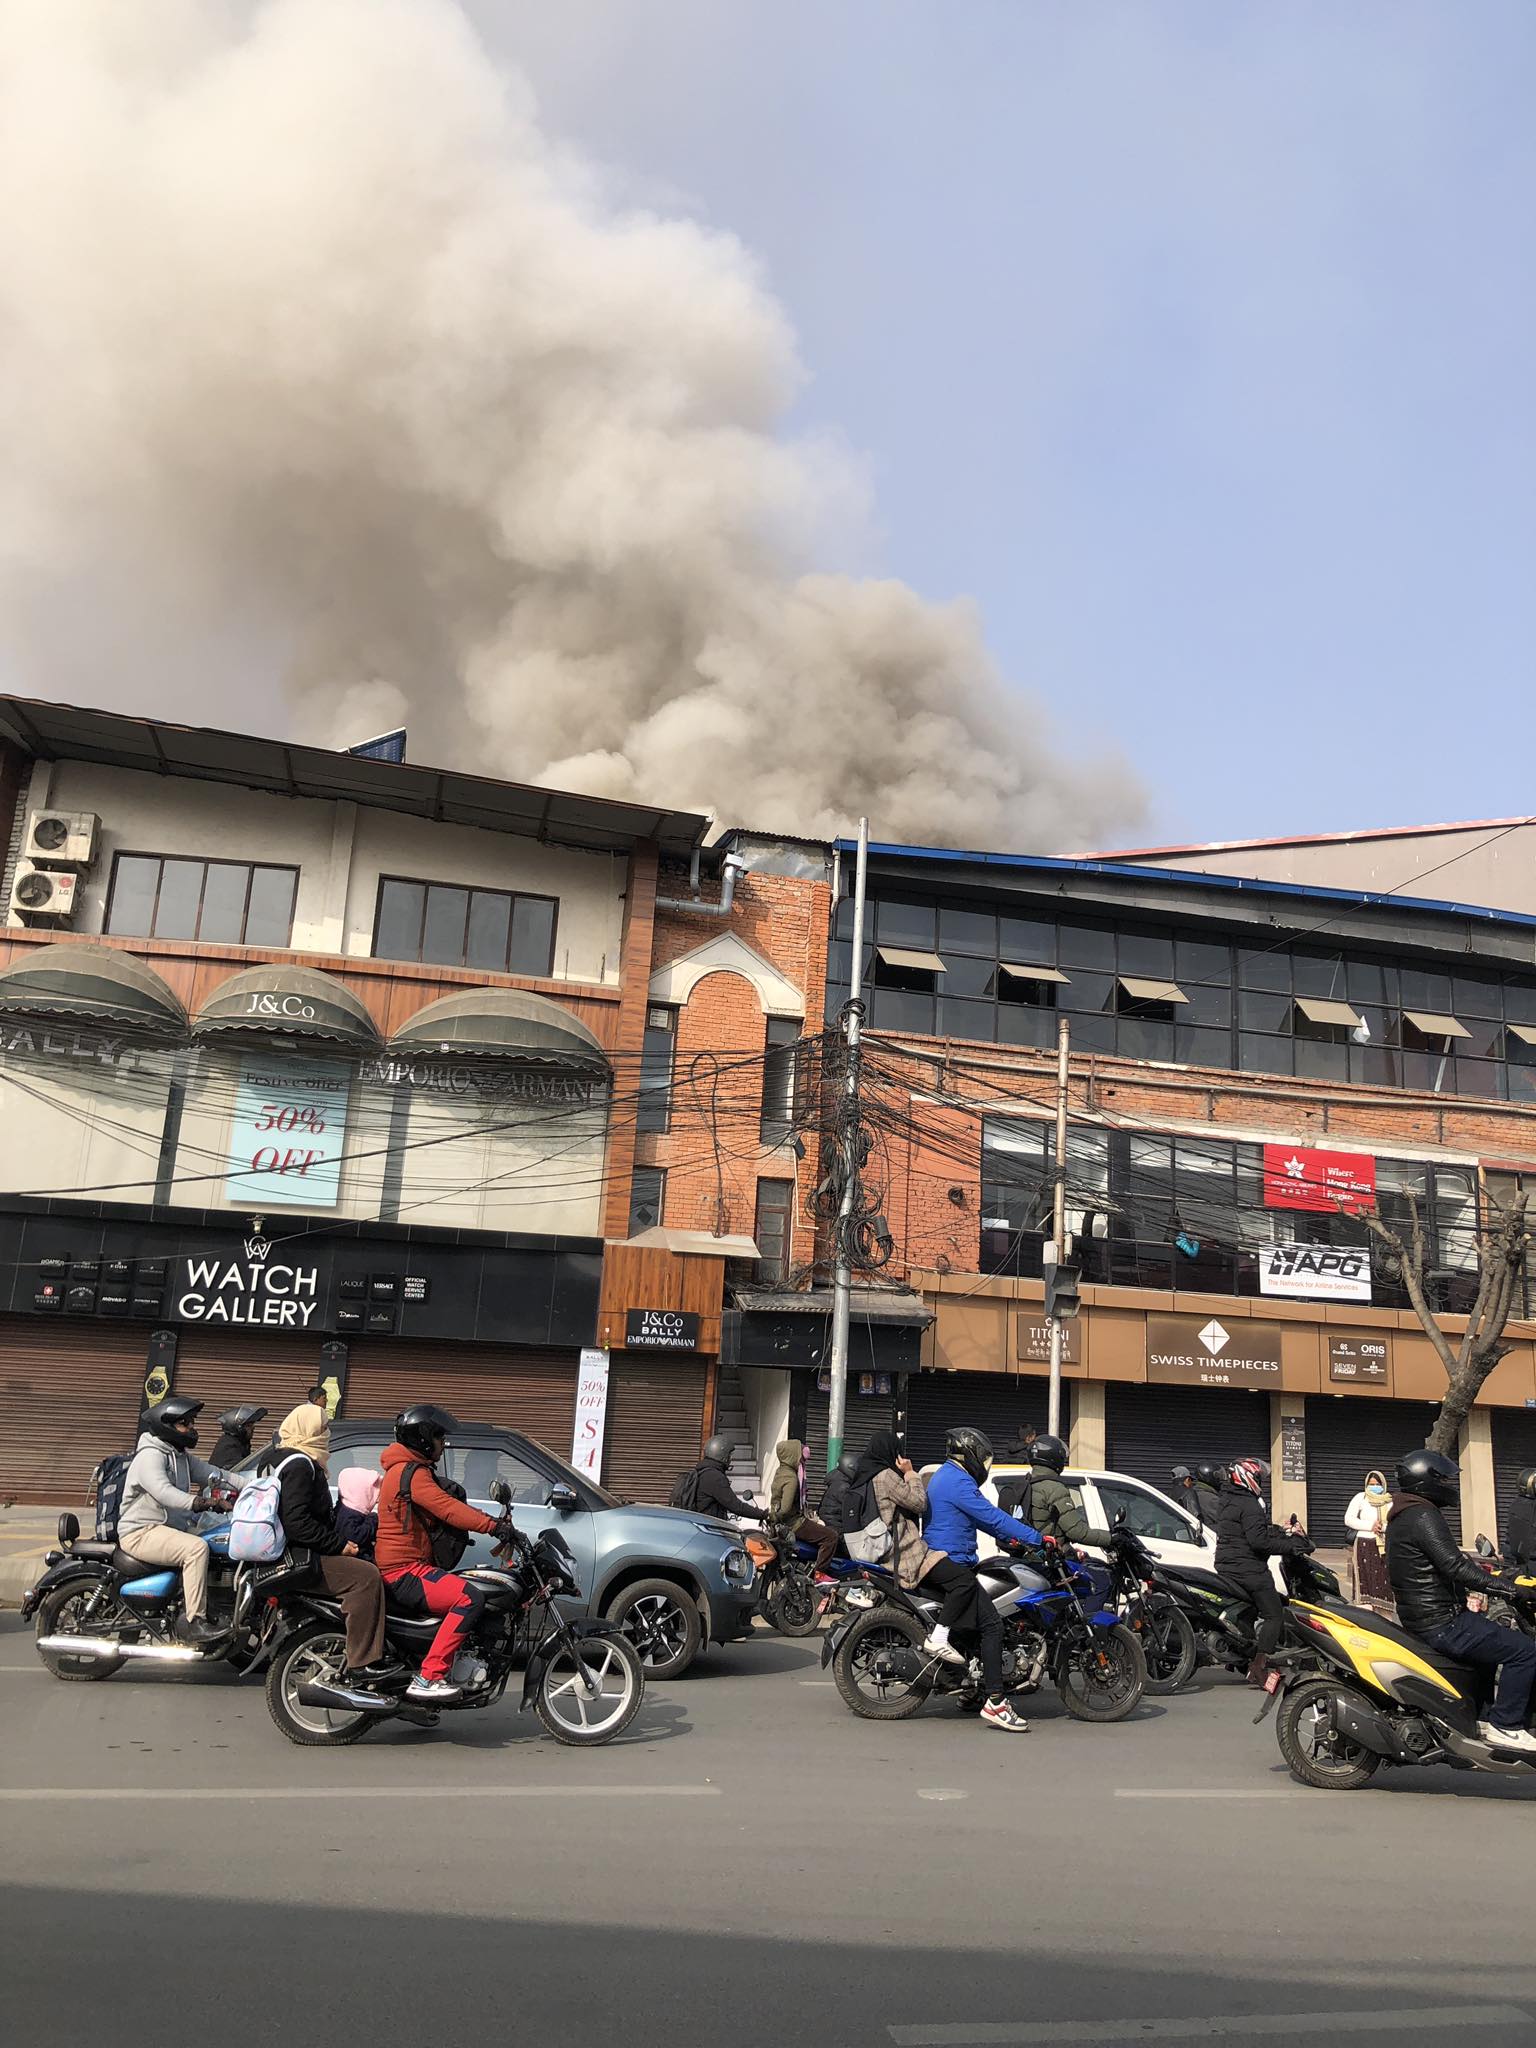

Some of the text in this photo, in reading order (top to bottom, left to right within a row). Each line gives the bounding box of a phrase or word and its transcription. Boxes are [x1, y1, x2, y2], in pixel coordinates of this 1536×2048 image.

[246, 994, 315, 1018] J&Co
[358, 1060, 472, 1094] EMPORIO
[255, 1105, 327, 1135] 50%
[251, 1146, 324, 1175] OFF
[1295, 1252, 1363, 1276] APG
[187, 1259, 318, 1296] WATCH
[178, 1293, 318, 1326] GALLERY
[642, 1311, 684, 1327] J&Co
[641, 1326, 682, 1336] BALLY
[1361, 1344, 1385, 1355] ORIS
[1150, 1354, 1279, 1371] SWISS TIMEPIECES
[580, 1380, 606, 1393] 50%
[580, 1396, 605, 1408] OFF
